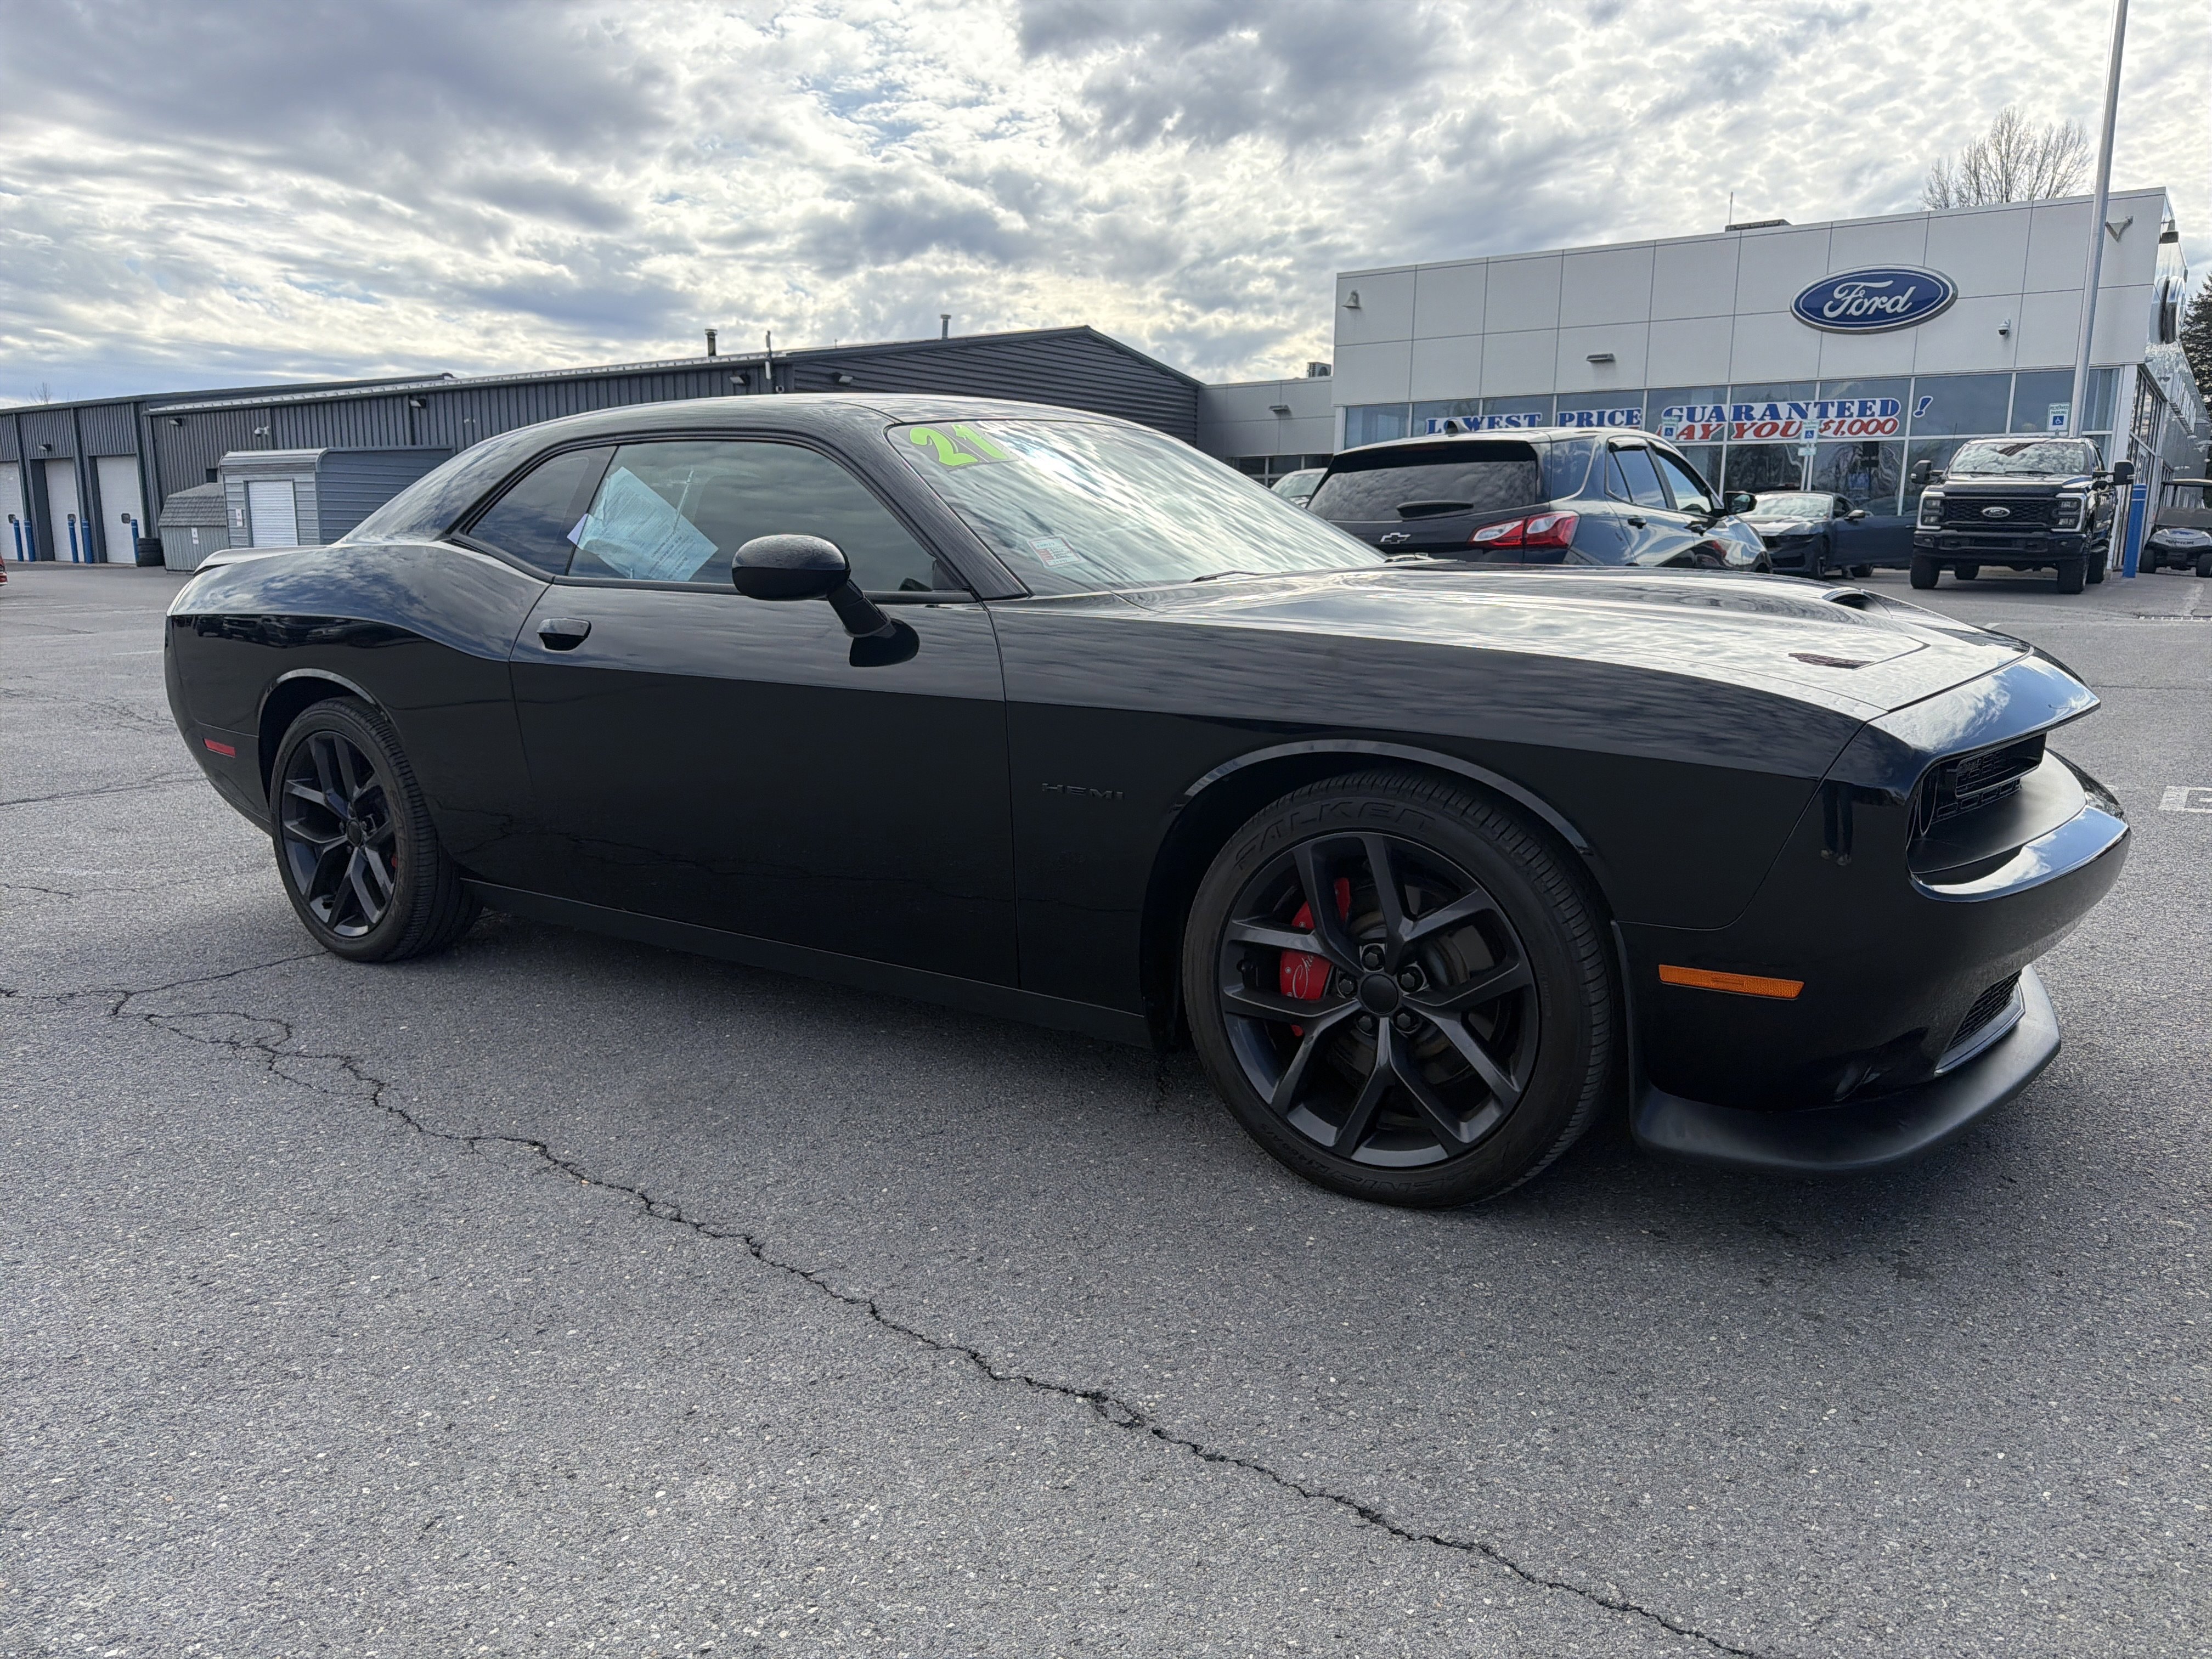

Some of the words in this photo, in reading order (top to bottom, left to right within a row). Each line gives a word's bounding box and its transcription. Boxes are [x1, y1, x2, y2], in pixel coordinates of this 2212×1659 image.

[1823, 280, 1916, 318] Ford
[1559, 409, 1641, 427] PRICE
[1663, 399, 1900, 423] GUARANTEED
[1657, 424, 1724, 439] AY
[1732, 421, 1802, 438] YOU
[1819, 419, 1898, 436] $1,000
[910, 424, 1008, 466] 21
[1041, 783, 1124, 800] HEMI
[1234, 801, 1436, 870] FALKEN
